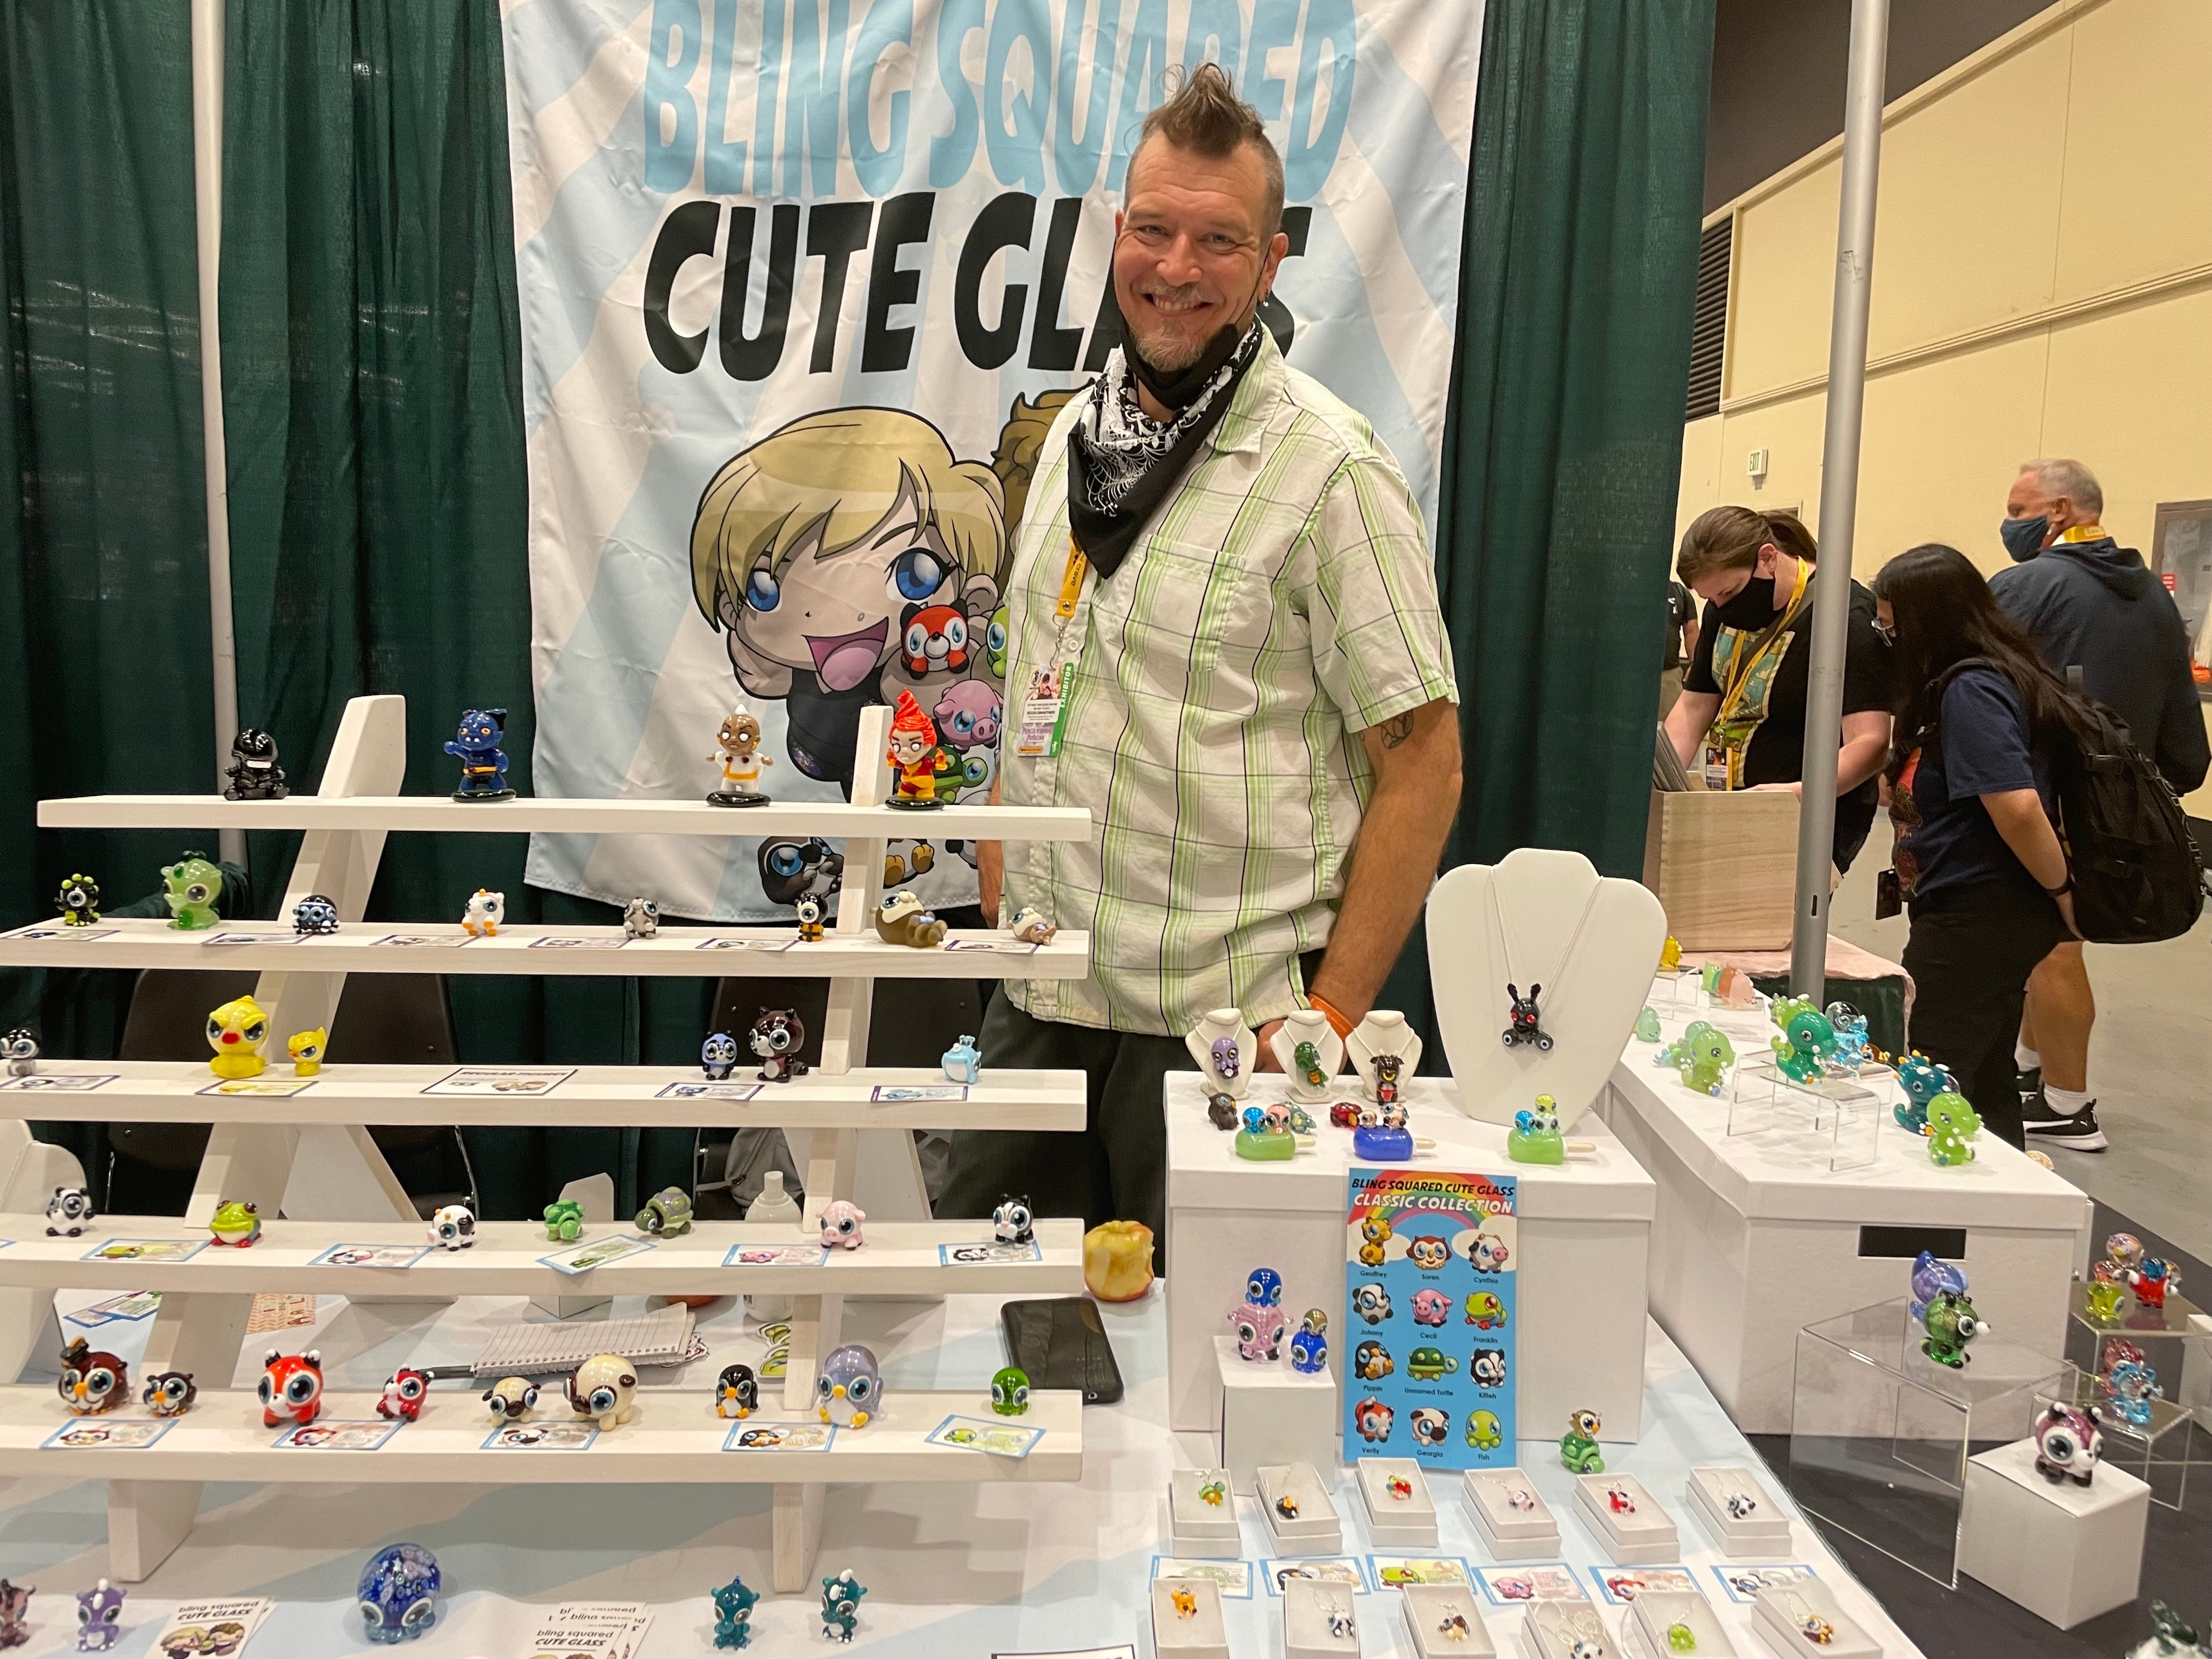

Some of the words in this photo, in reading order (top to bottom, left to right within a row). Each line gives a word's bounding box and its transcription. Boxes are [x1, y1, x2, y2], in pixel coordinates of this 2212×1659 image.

[644, 0, 917, 198] BLING
[643, 191, 936, 382] CUTE
[1750, 452, 1760, 471] EXIT
[1070, 563, 1081, 586] crave
[1059, 665, 1072, 708] EXHIBITOR
[1352, 1178, 1386, 1189] BLING
[1389, 1180, 1442, 1192] SQUARED
[1445, 1183, 1475, 1194] CUTE
[1477, 1185, 1514, 1196] GLASS
[1353, 1193, 1415, 1207] CLASSIC
[1418, 1196, 1513, 1214] COLLECTION
[1474, 1277, 1498, 1285] Cynthia
[1360, 1329, 1383, 1338] Johnny
[1473, 1336, 1498, 1344] Franklin
[1417, 1449, 1443, 1458] Georgia
[178, 1611, 211, 1620] CUTE
